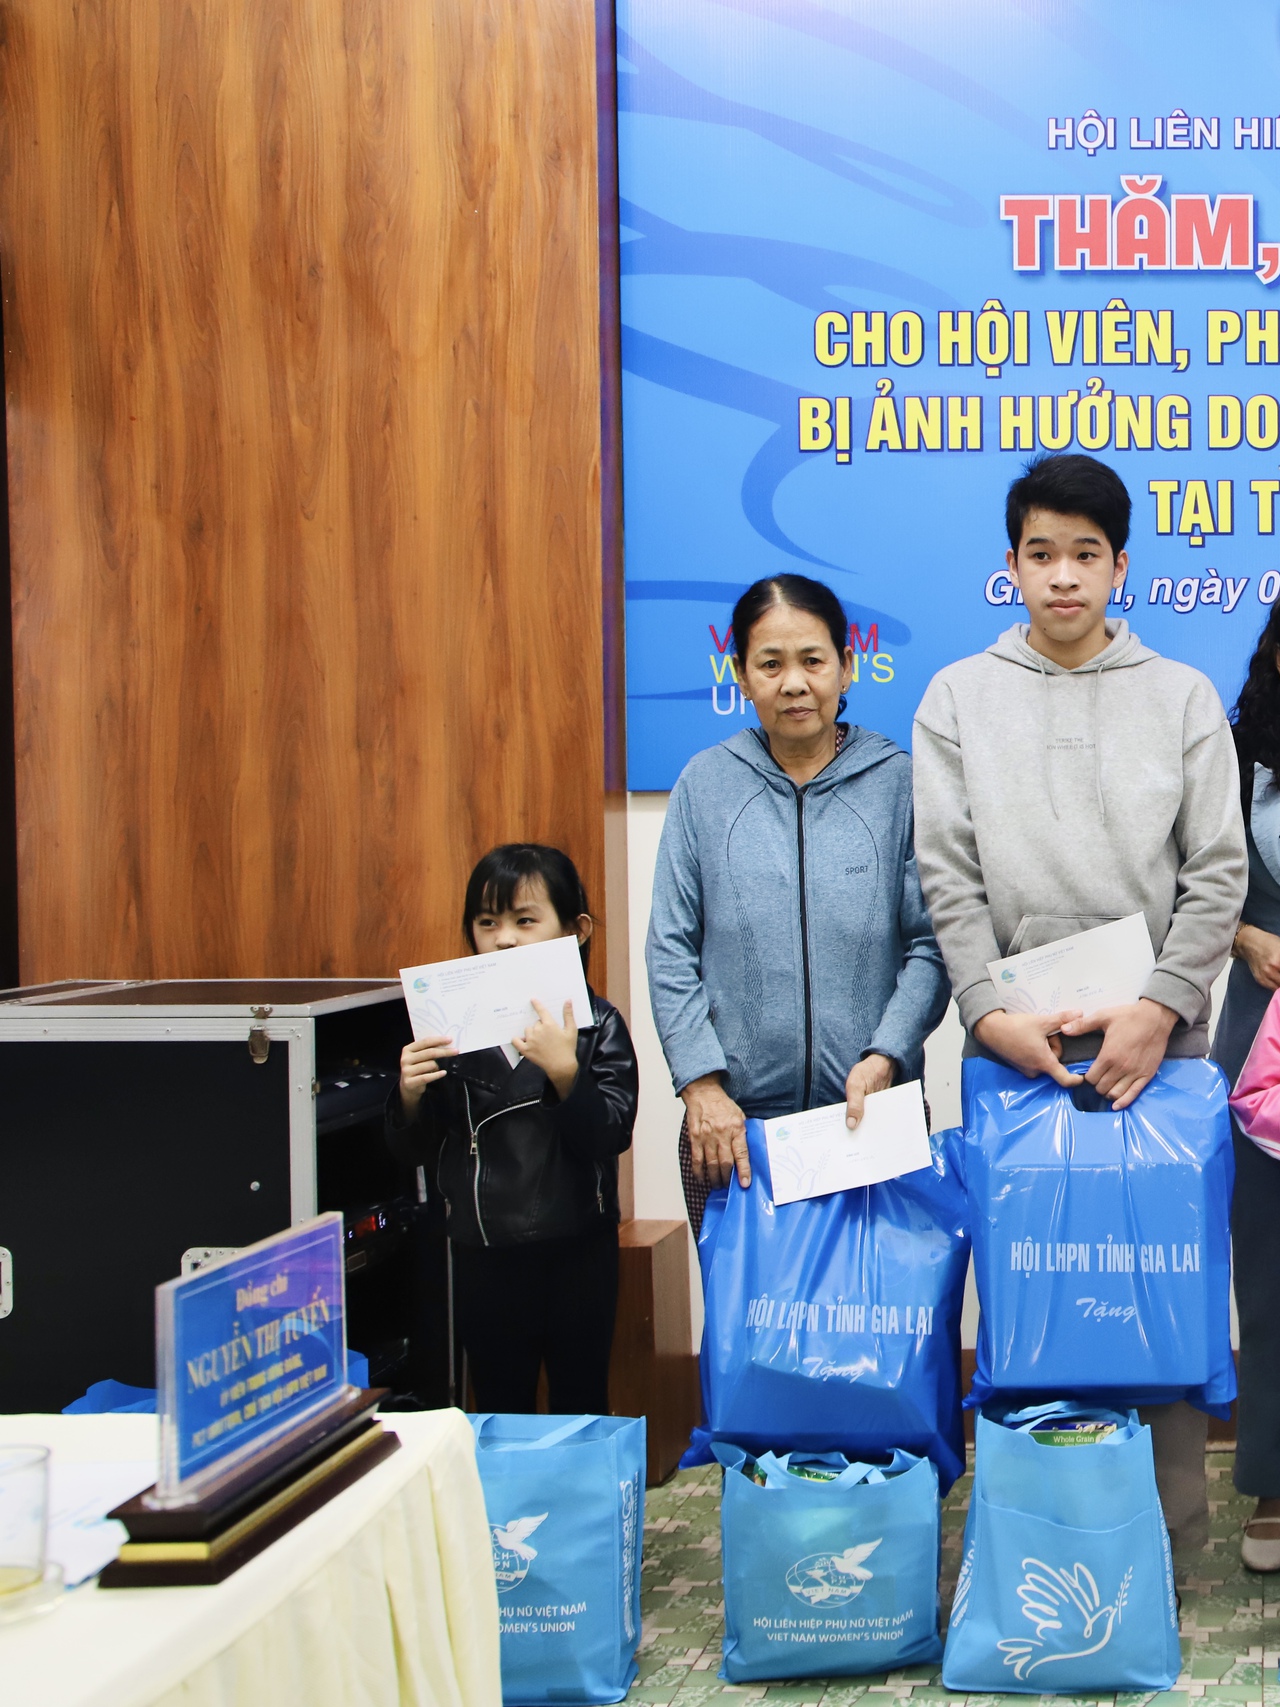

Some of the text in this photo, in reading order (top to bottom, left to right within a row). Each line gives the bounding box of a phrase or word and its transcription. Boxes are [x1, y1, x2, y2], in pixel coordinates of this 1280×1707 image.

[1047, 110, 1117, 157] HỘI
[1130, 110, 1220, 150] LIÊN
[814, 310, 923, 366] CHO
[937, 298, 1031, 378] HỘI
[1046, 298, 1190, 372] VIÊN,
[798, 396, 852, 464] BỊ
[866, 378, 982, 452] ẢNH
[999, 377, 1192, 452] HƯỞNG
[1149, 479, 1232, 547] TẠI
[1148, 568, 1249, 613] ngày
[845, 865, 869, 876] SPORT
[1010, 1234, 1200, 1278] HỘI LHPN TỈNH GIA LAI
[746, 1293, 934, 1335] HỘI LHPN TỈNH GIA LAI
[1076, 1297, 1137, 1323] Tặng
[1053, 1435, 1095, 1443] Whole Grain
[499, 1601, 587, 1618] HỤ NỮ VIỆT NAM
[753, 1609, 913, 1630] HỘI LIÊN HIỆP PHỤ NỮ VIỆT NAM
[499, 1621, 575, 1634] OMEN'S UNION
[767, 1629, 904, 1643] VIET NAM WOMEN'S UNION
